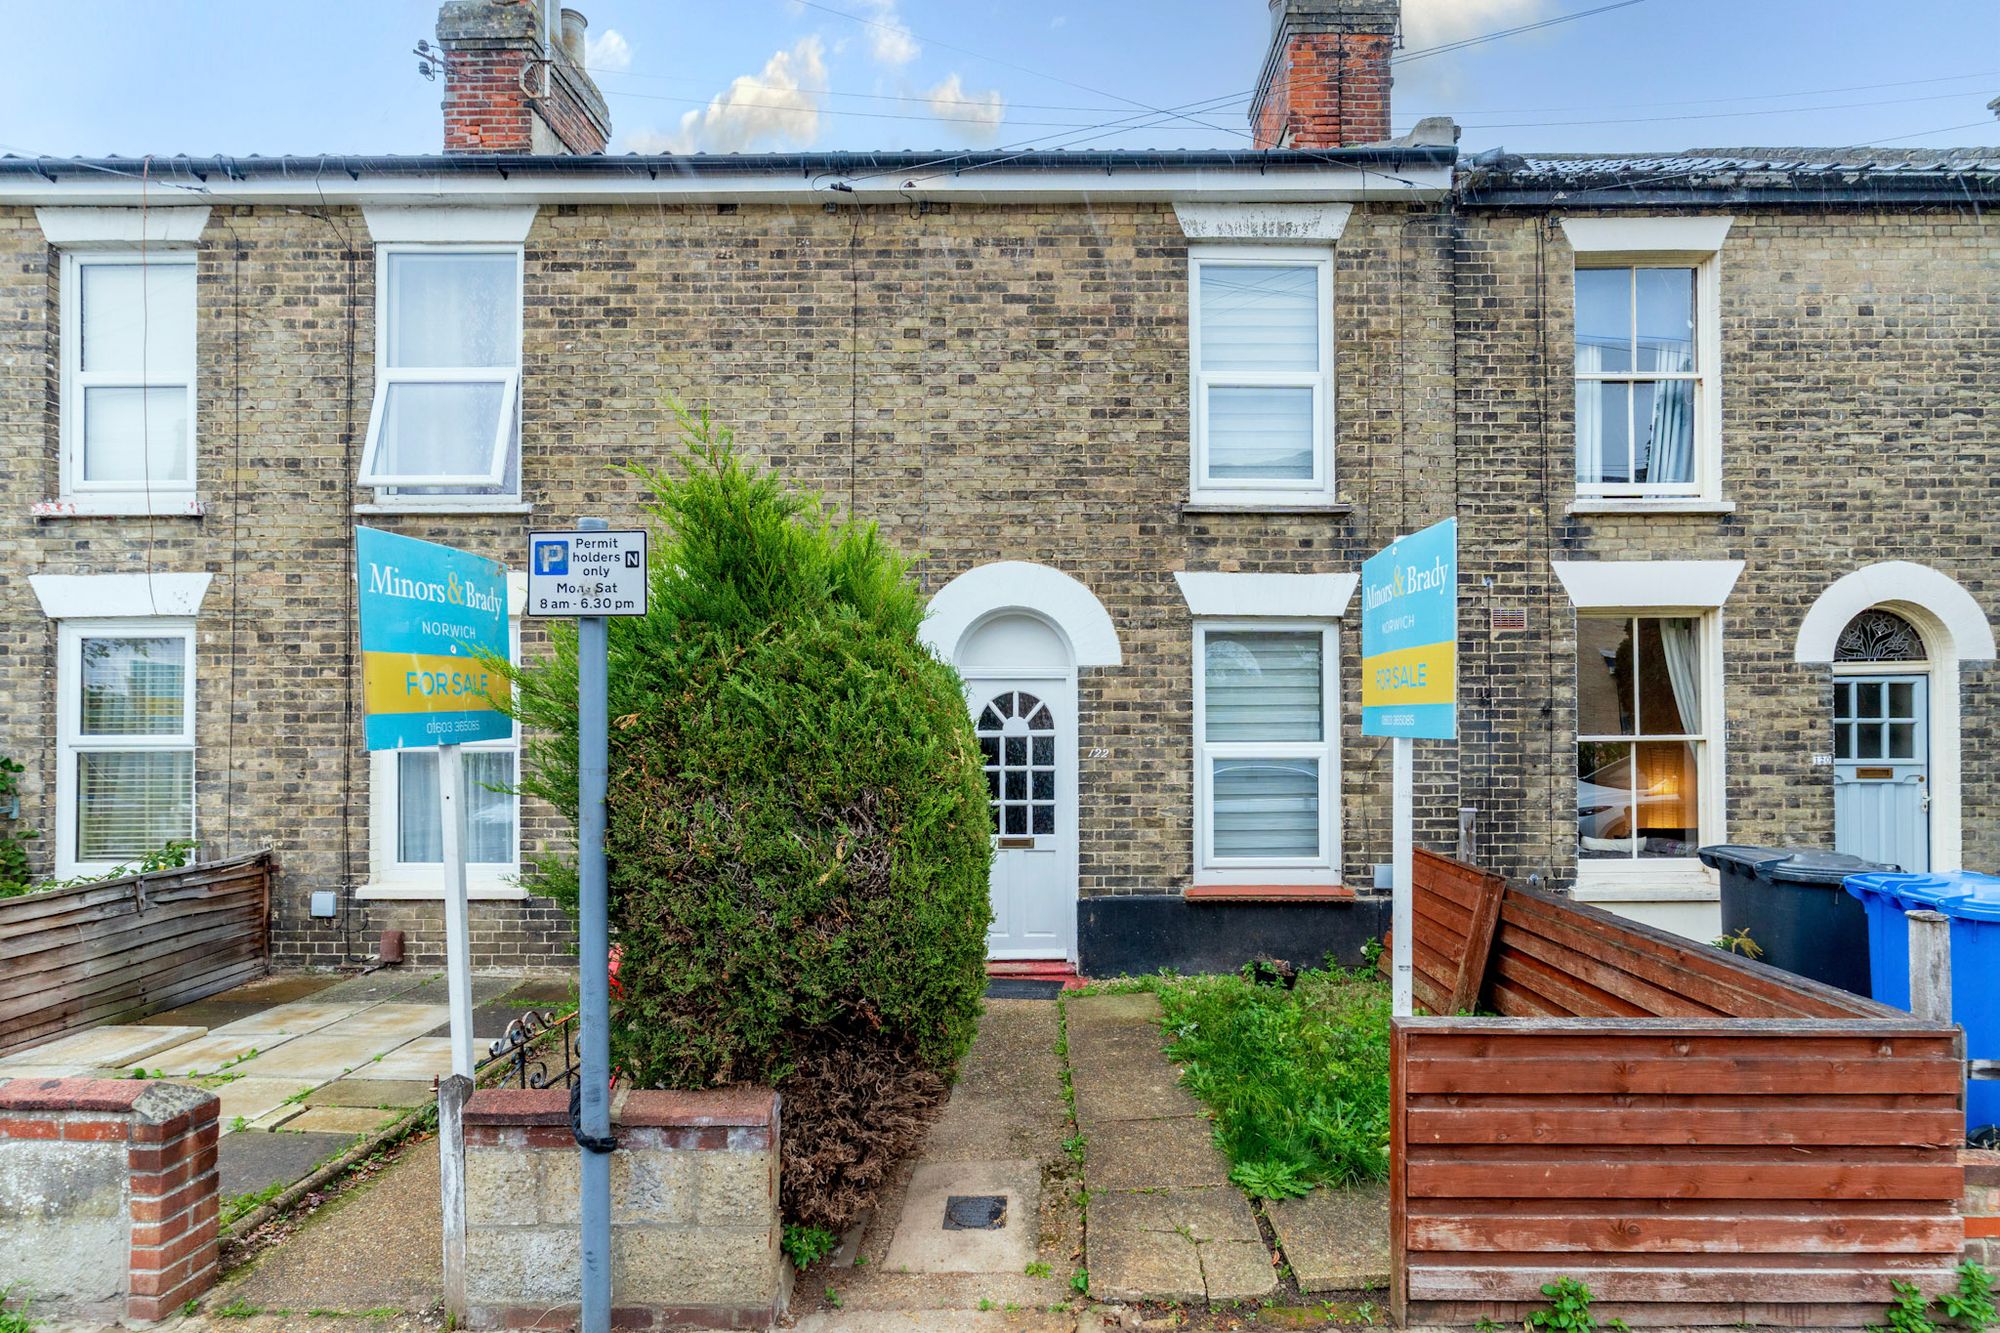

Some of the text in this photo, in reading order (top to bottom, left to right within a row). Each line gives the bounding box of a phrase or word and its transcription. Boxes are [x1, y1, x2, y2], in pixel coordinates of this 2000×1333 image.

[576, 538, 618, 549] Permit
[543, 545, 564, 573] P
[572, 552, 621, 562] holders
[627, 552, 639, 566] N
[583, 566, 610, 578] only
[595, 582, 618, 593] Sat
[1365, 555, 1449, 612] Minors & Brady
[368, 562, 502, 621] Minors & Brady
[540, 599, 548, 609] 8
[551, 600, 570, 609] am
[580, 598, 612, 609] 6.30
[615, 601, 635, 610] pm
[421, 621, 476, 639] NORWICH
[1376, 663, 1427, 690] FOR SALE
[406, 671, 488, 696] FOR SALE
[426, 721, 453, 734] 01603
[1087, 748, 1110, 758] 122
